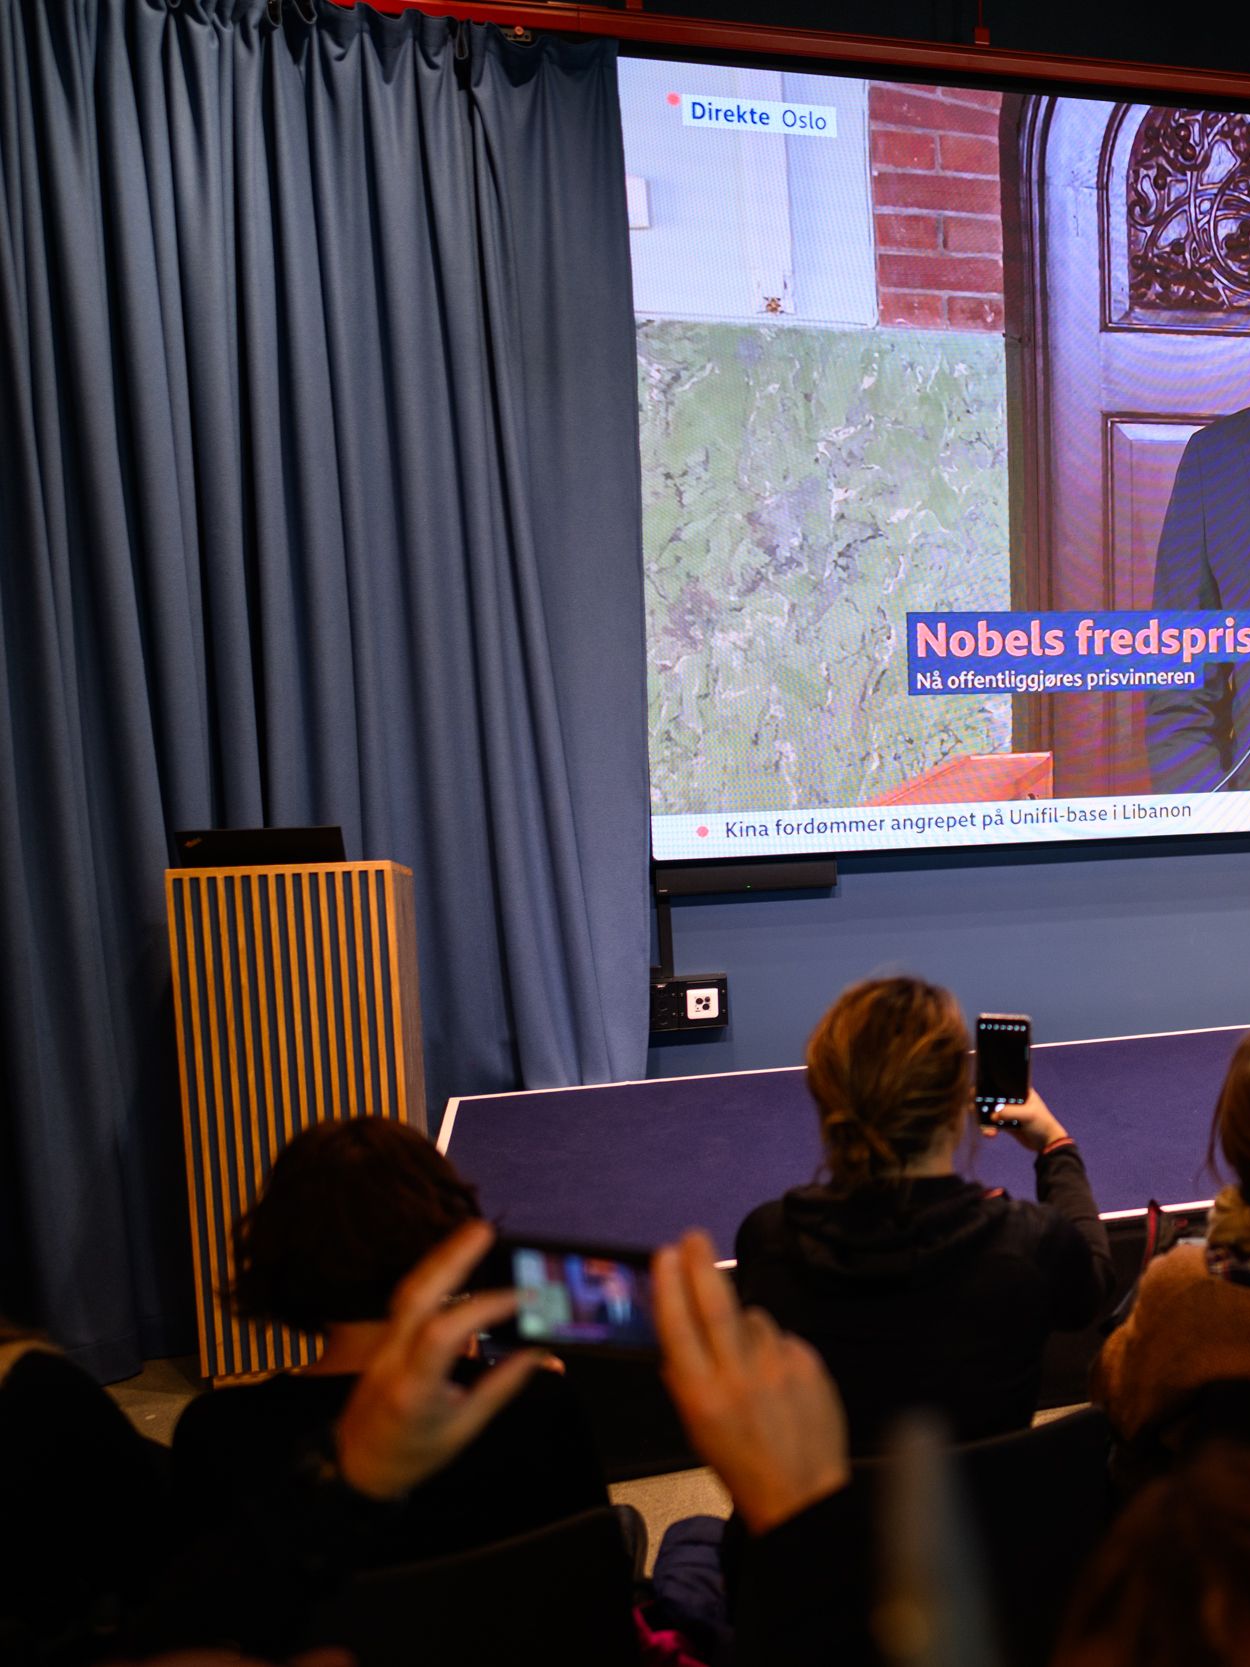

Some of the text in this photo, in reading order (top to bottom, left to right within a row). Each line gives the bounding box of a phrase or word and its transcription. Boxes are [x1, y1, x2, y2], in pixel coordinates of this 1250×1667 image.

[691, 102, 827, 130] Direkte Oslo
[916, 619, 1065, 657] Nobels
[916, 667, 1196, 693] Nå offentliggjøres prisvinneren
[725, 821, 769, 838] Kina
[775, 818, 886, 836] fordømmer
[890, 812, 976, 833] angrepet
[982, 808, 1005, 830] på
[1009, 807, 1108, 825] Unifil-base
[1123, 803, 1192, 820] Libanon
